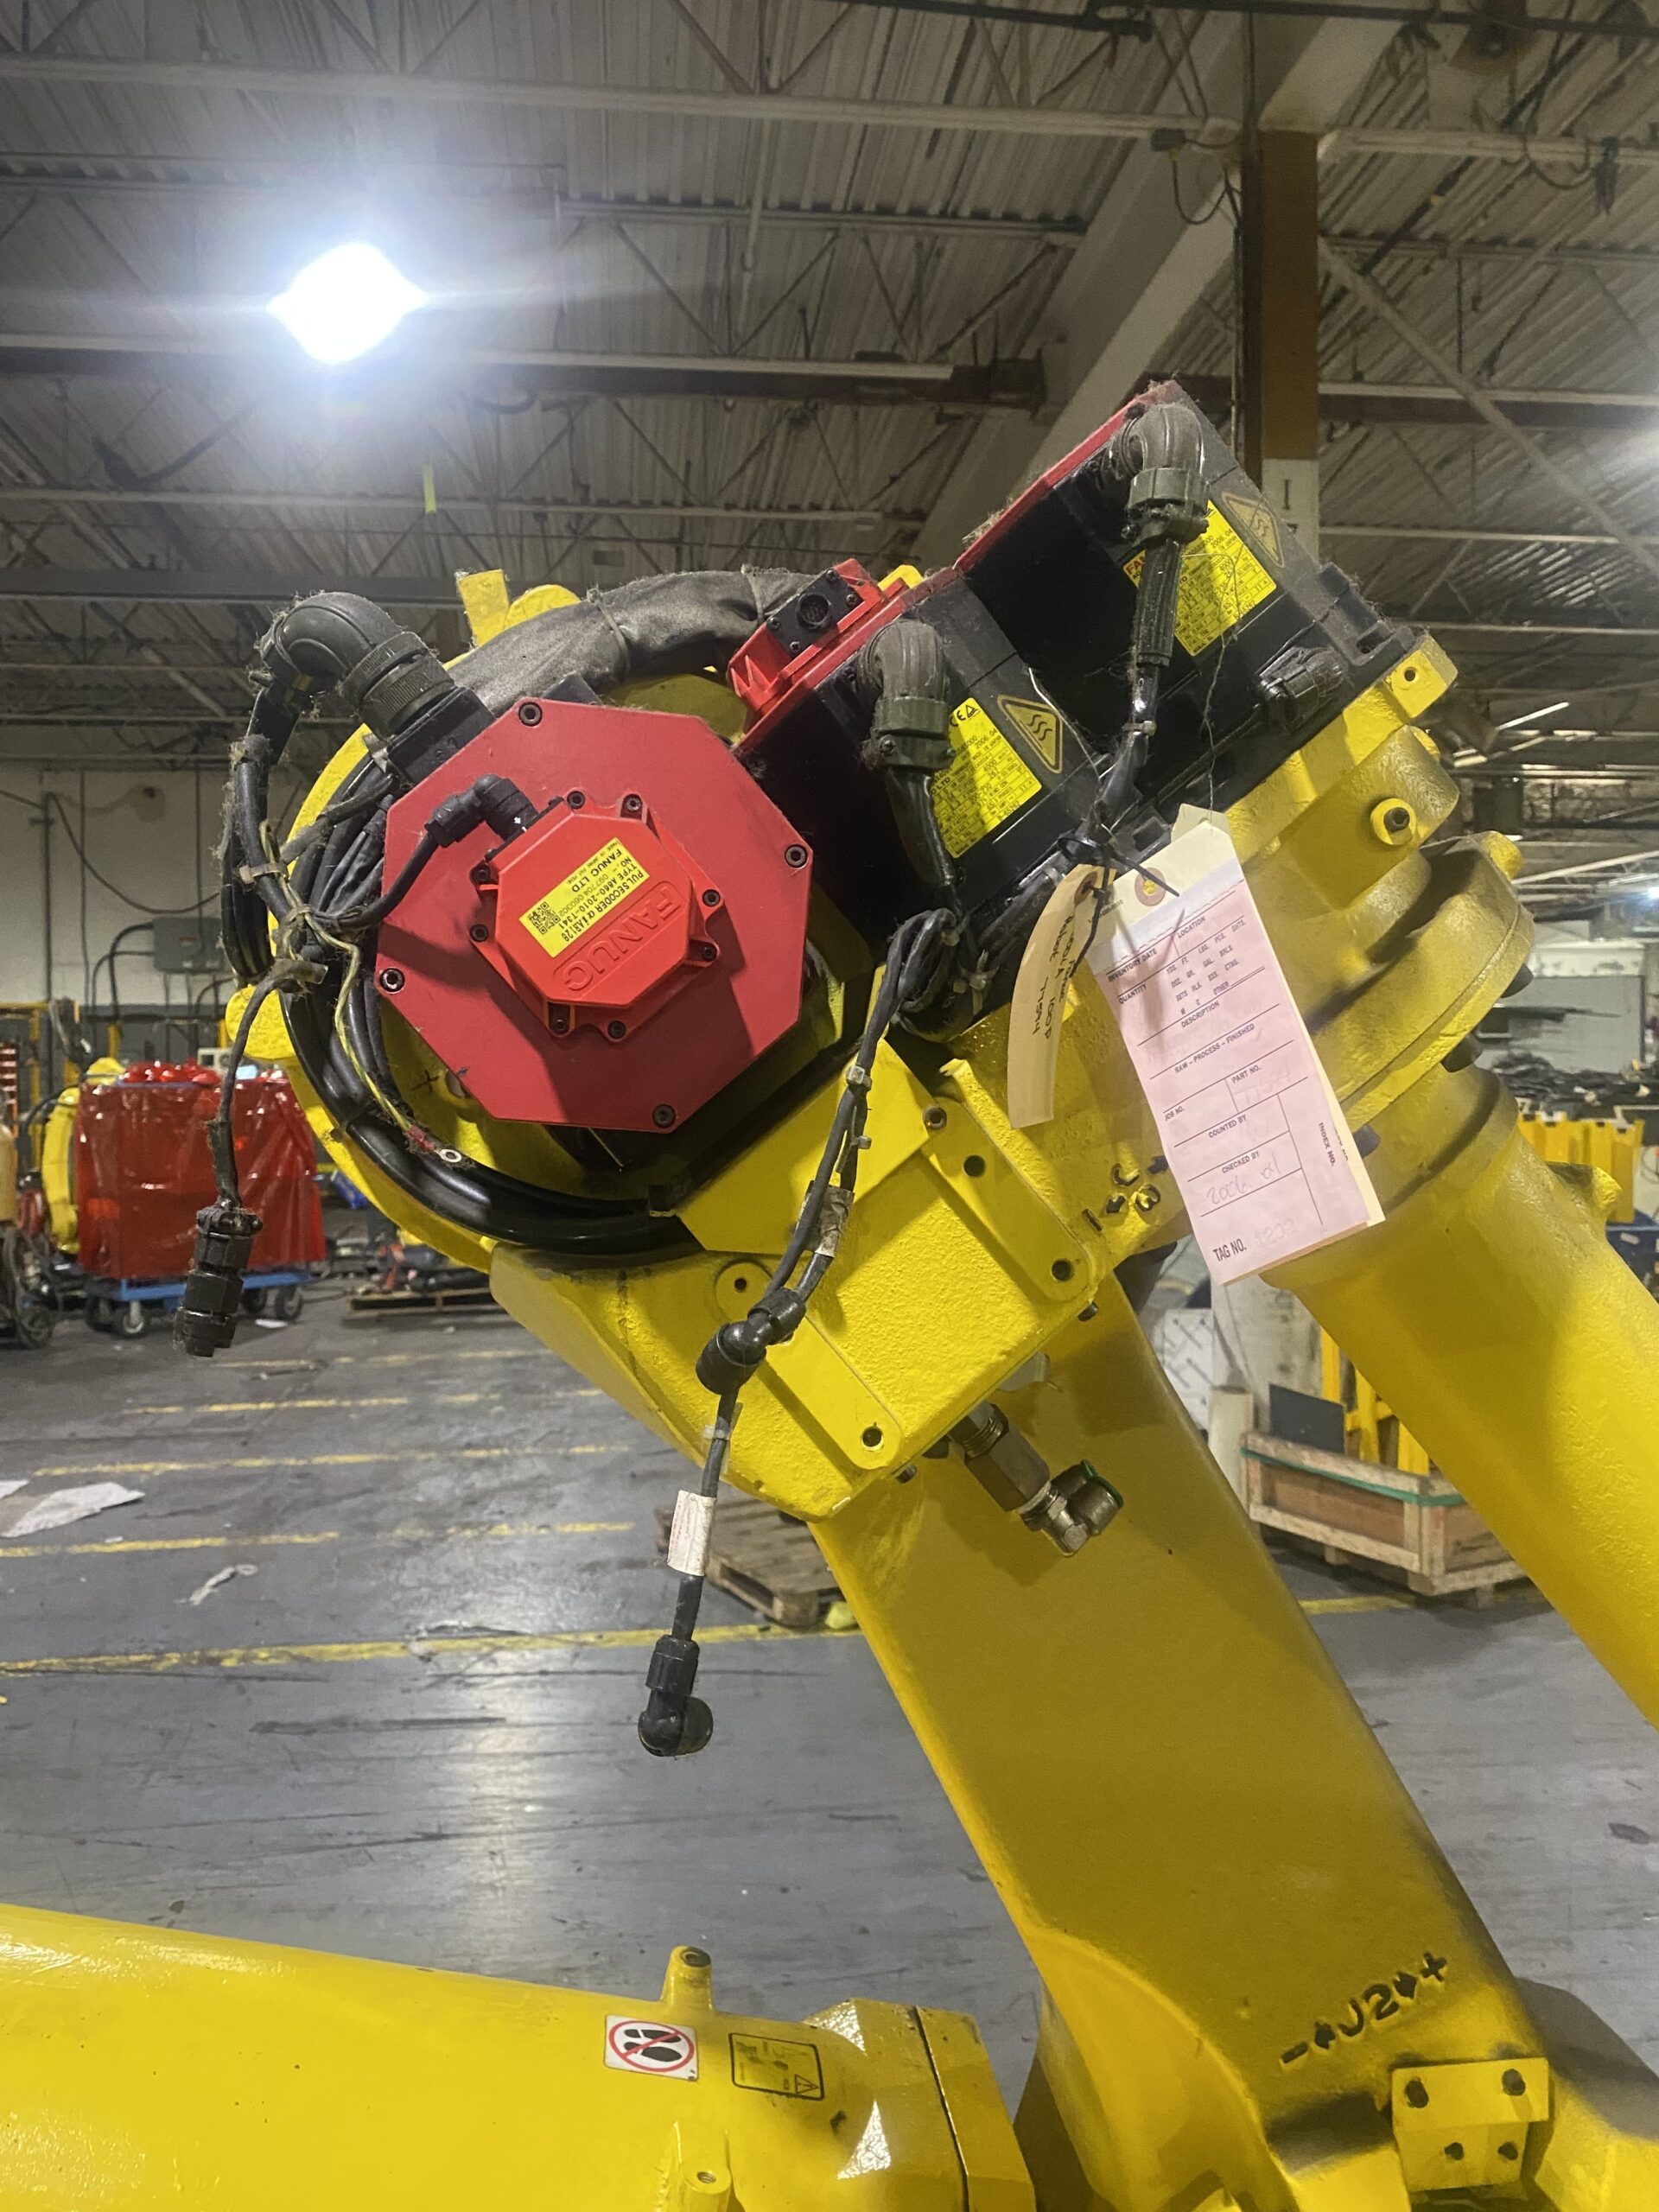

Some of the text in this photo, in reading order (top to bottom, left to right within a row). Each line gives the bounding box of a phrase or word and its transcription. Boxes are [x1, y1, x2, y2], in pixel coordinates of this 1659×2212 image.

[570, 848, 622, 893] FANUC LTD
[616, 861, 636, 880] TYPE
[594, 869, 643, 913] PULSECODER
[563, 885, 681, 991] FANUC
[1176, 916, 1205, 938] LOCATION
[1107, 948, 1157, 981] INVENTORY DATE
[1119, 983, 1147, 1004] QUANTITY
[1180, 1001, 1220, 1027] DESCRIPTION
[1173, 1061, 1189, 1073] RAW
[1192, 1042, 1221, 1062] PROCESS
[1224, 1022, 1255, 1044] FINISHED
[1230, 1063, 1262, 1084] PART NO.
[1207, 1118, 1237, 1139] COUNTED
[1236, 1113, 1248, 1123] BY
[1318, 1122, 1337, 1166] INDEX NO.
[1221, 1150, 1261, 1173] CHECKED BY
[1212, 1243, 1231, 1262] TAG
[1228, 1236, 1247, 1255] NO.
